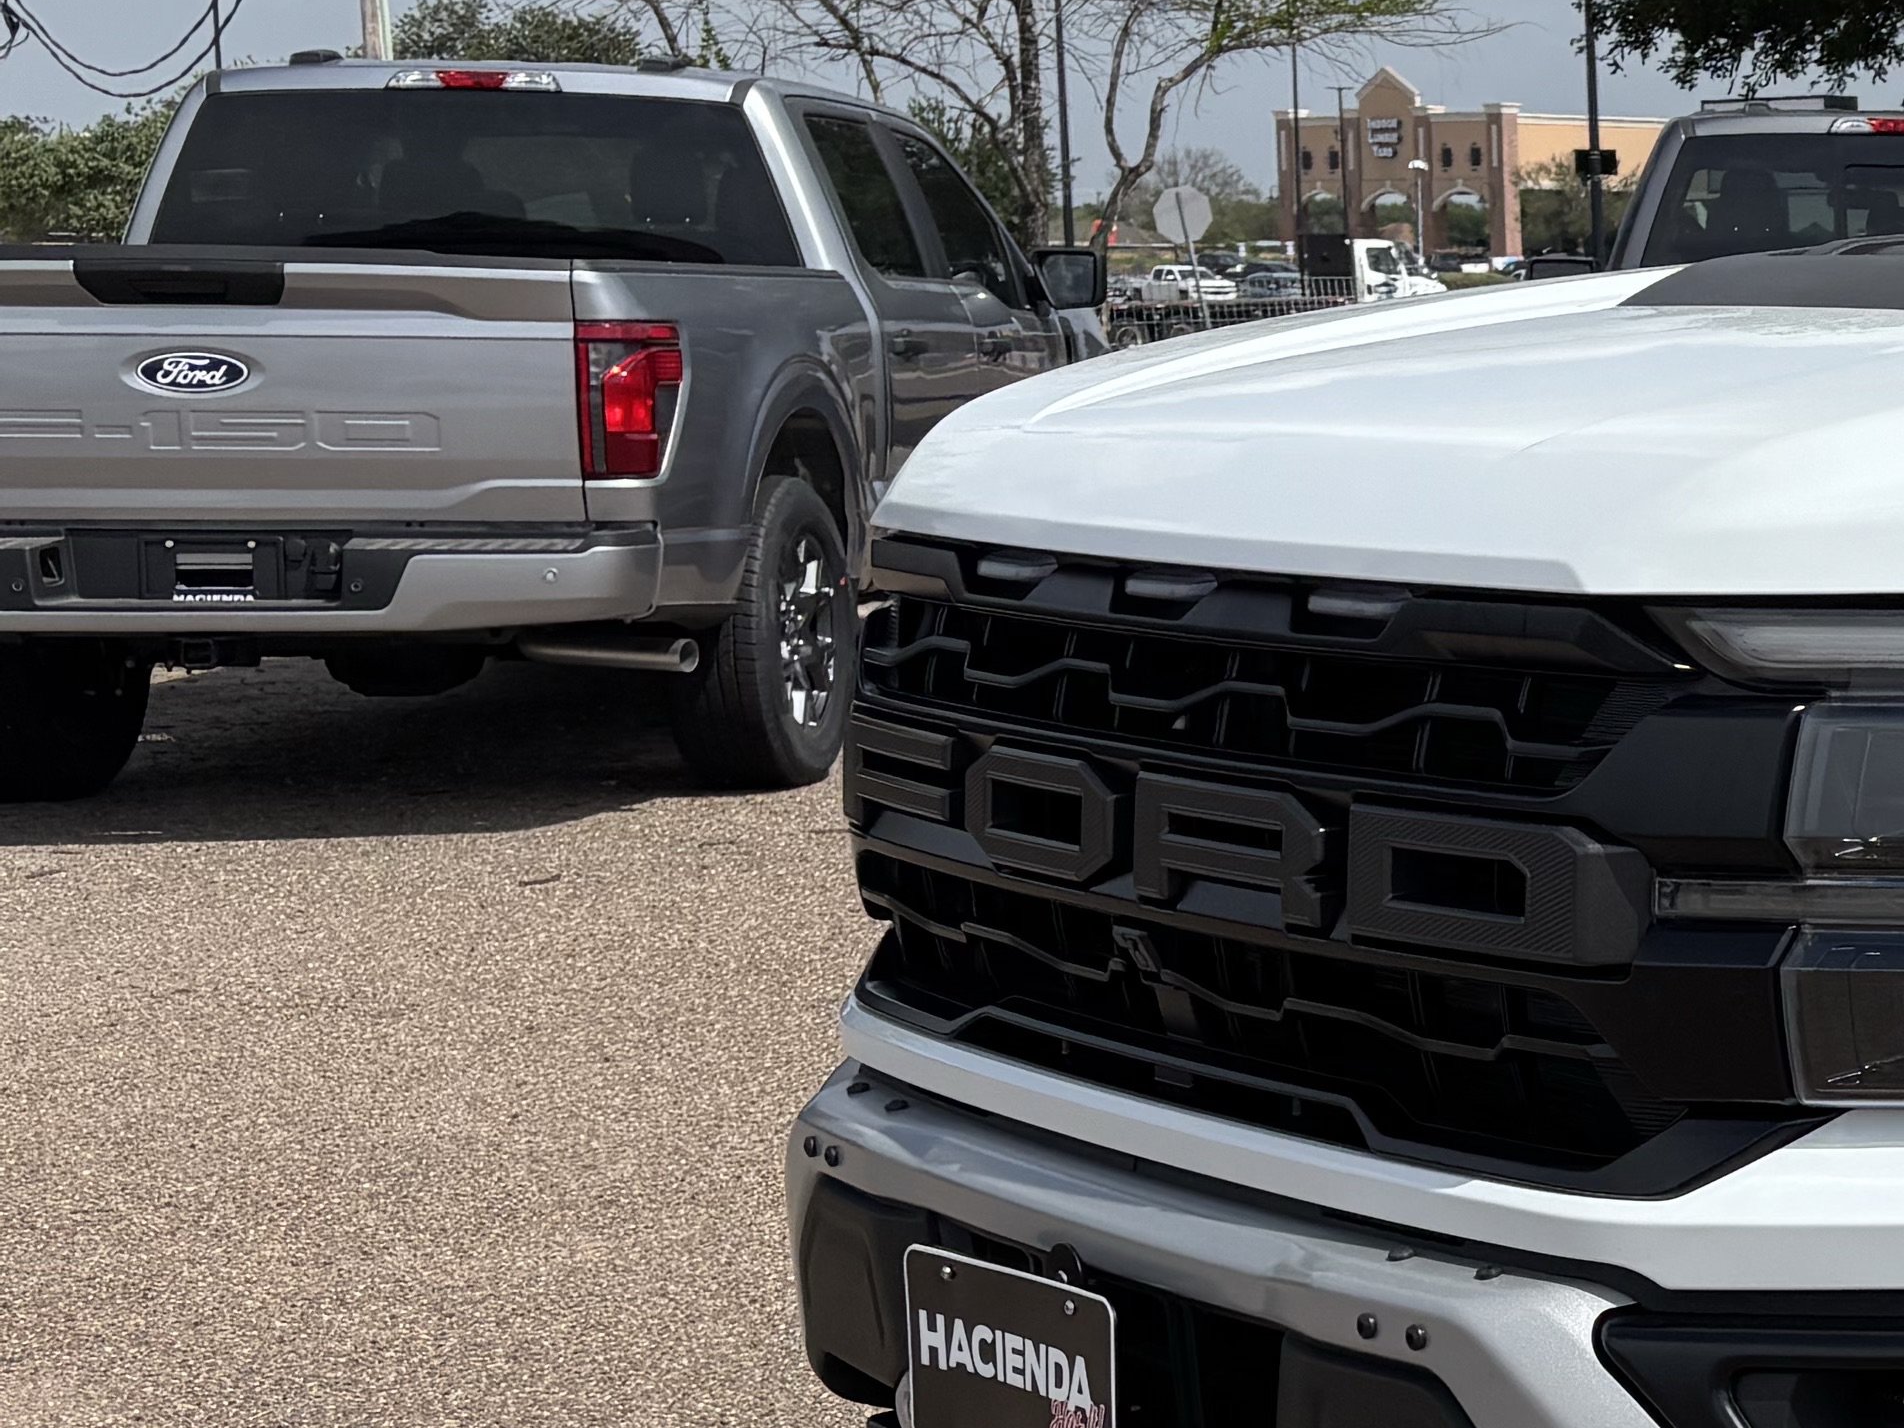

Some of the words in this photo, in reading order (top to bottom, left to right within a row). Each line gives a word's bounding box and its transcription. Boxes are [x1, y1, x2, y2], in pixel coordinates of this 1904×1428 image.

[155, 357, 228, 386] Ford
[843, 708, 1648, 968] FORD
[918, 1308, 1092, 1414] HACIENDA
